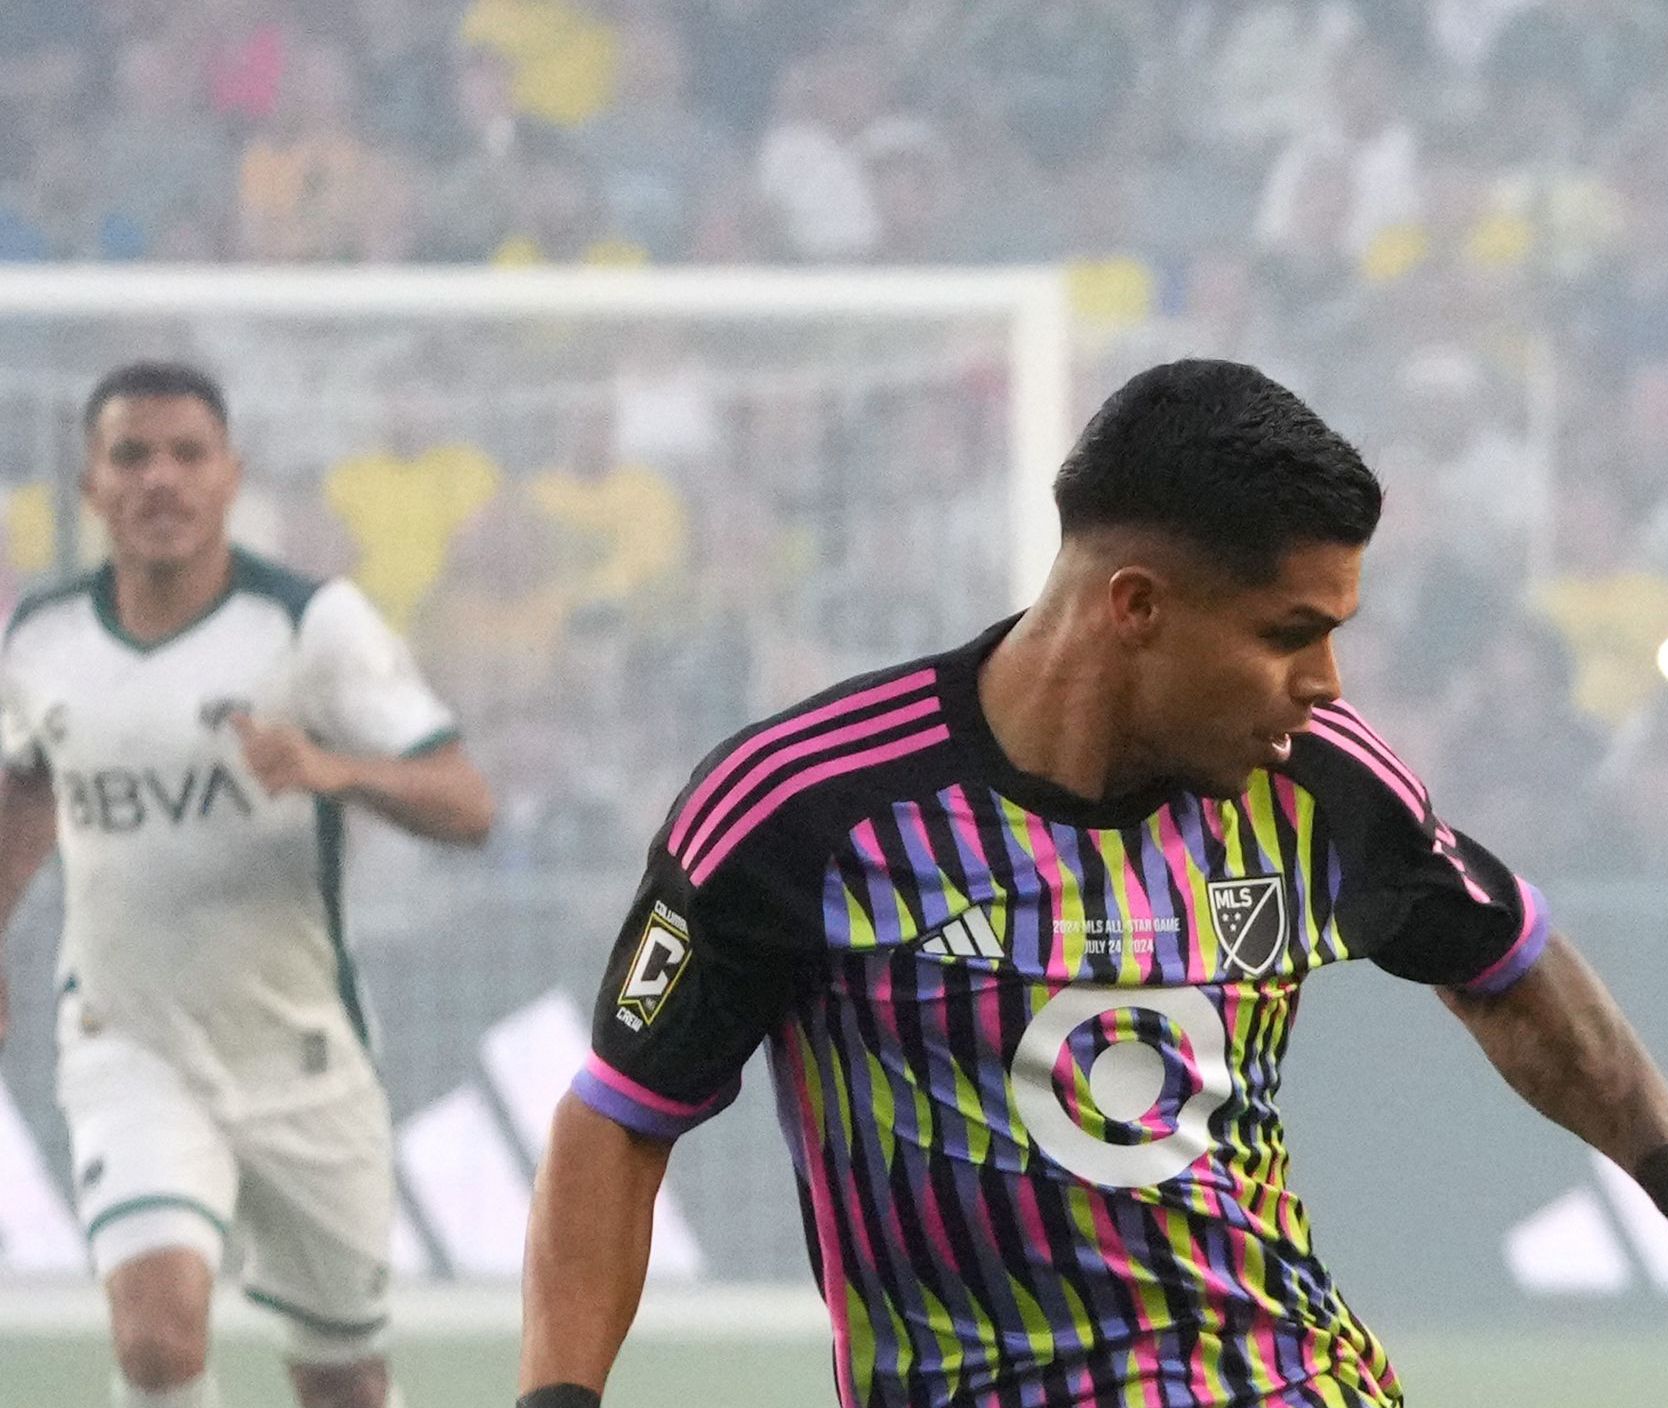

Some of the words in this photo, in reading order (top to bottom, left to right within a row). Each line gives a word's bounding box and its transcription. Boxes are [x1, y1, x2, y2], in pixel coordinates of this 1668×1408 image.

[66, 764, 252, 832] BBVA
[1214, 887, 1253, 909] MLS
[1153, 918, 1180, 932] GAME
[616, 1007, 643, 1032] CREW
